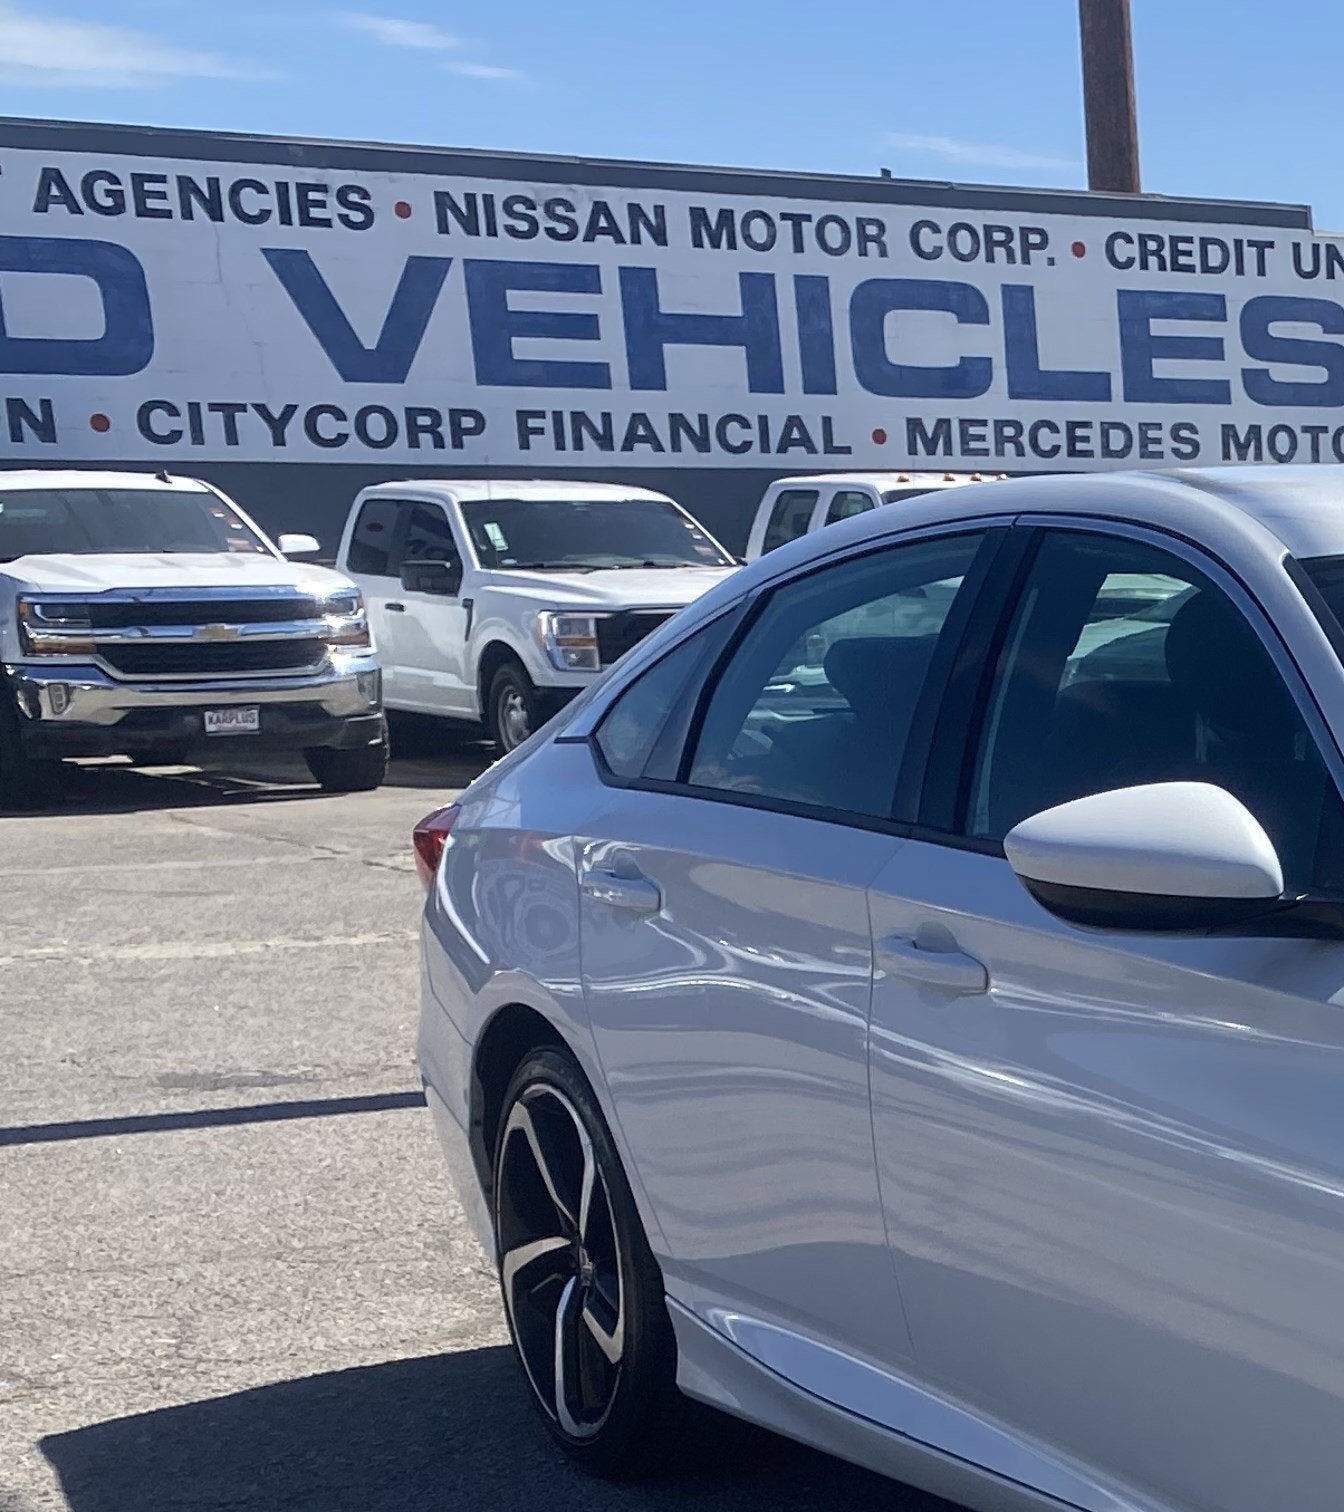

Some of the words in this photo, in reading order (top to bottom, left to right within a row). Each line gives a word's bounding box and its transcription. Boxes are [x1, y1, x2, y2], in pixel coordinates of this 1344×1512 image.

[32, 166, 375, 231] AGENCIES
[433, 190, 669, 247] NISSAN
[689, 206, 889, 258] MOTOR
[909, 219, 1056, 266] CORP.
[1104, 231, 1276, 277] CREDIT
[136, 398, 487, 450] CITYCORP
[515, 408, 853, 455] FINANCIAL
[905, 415, 1202, 461] MERCEDES
